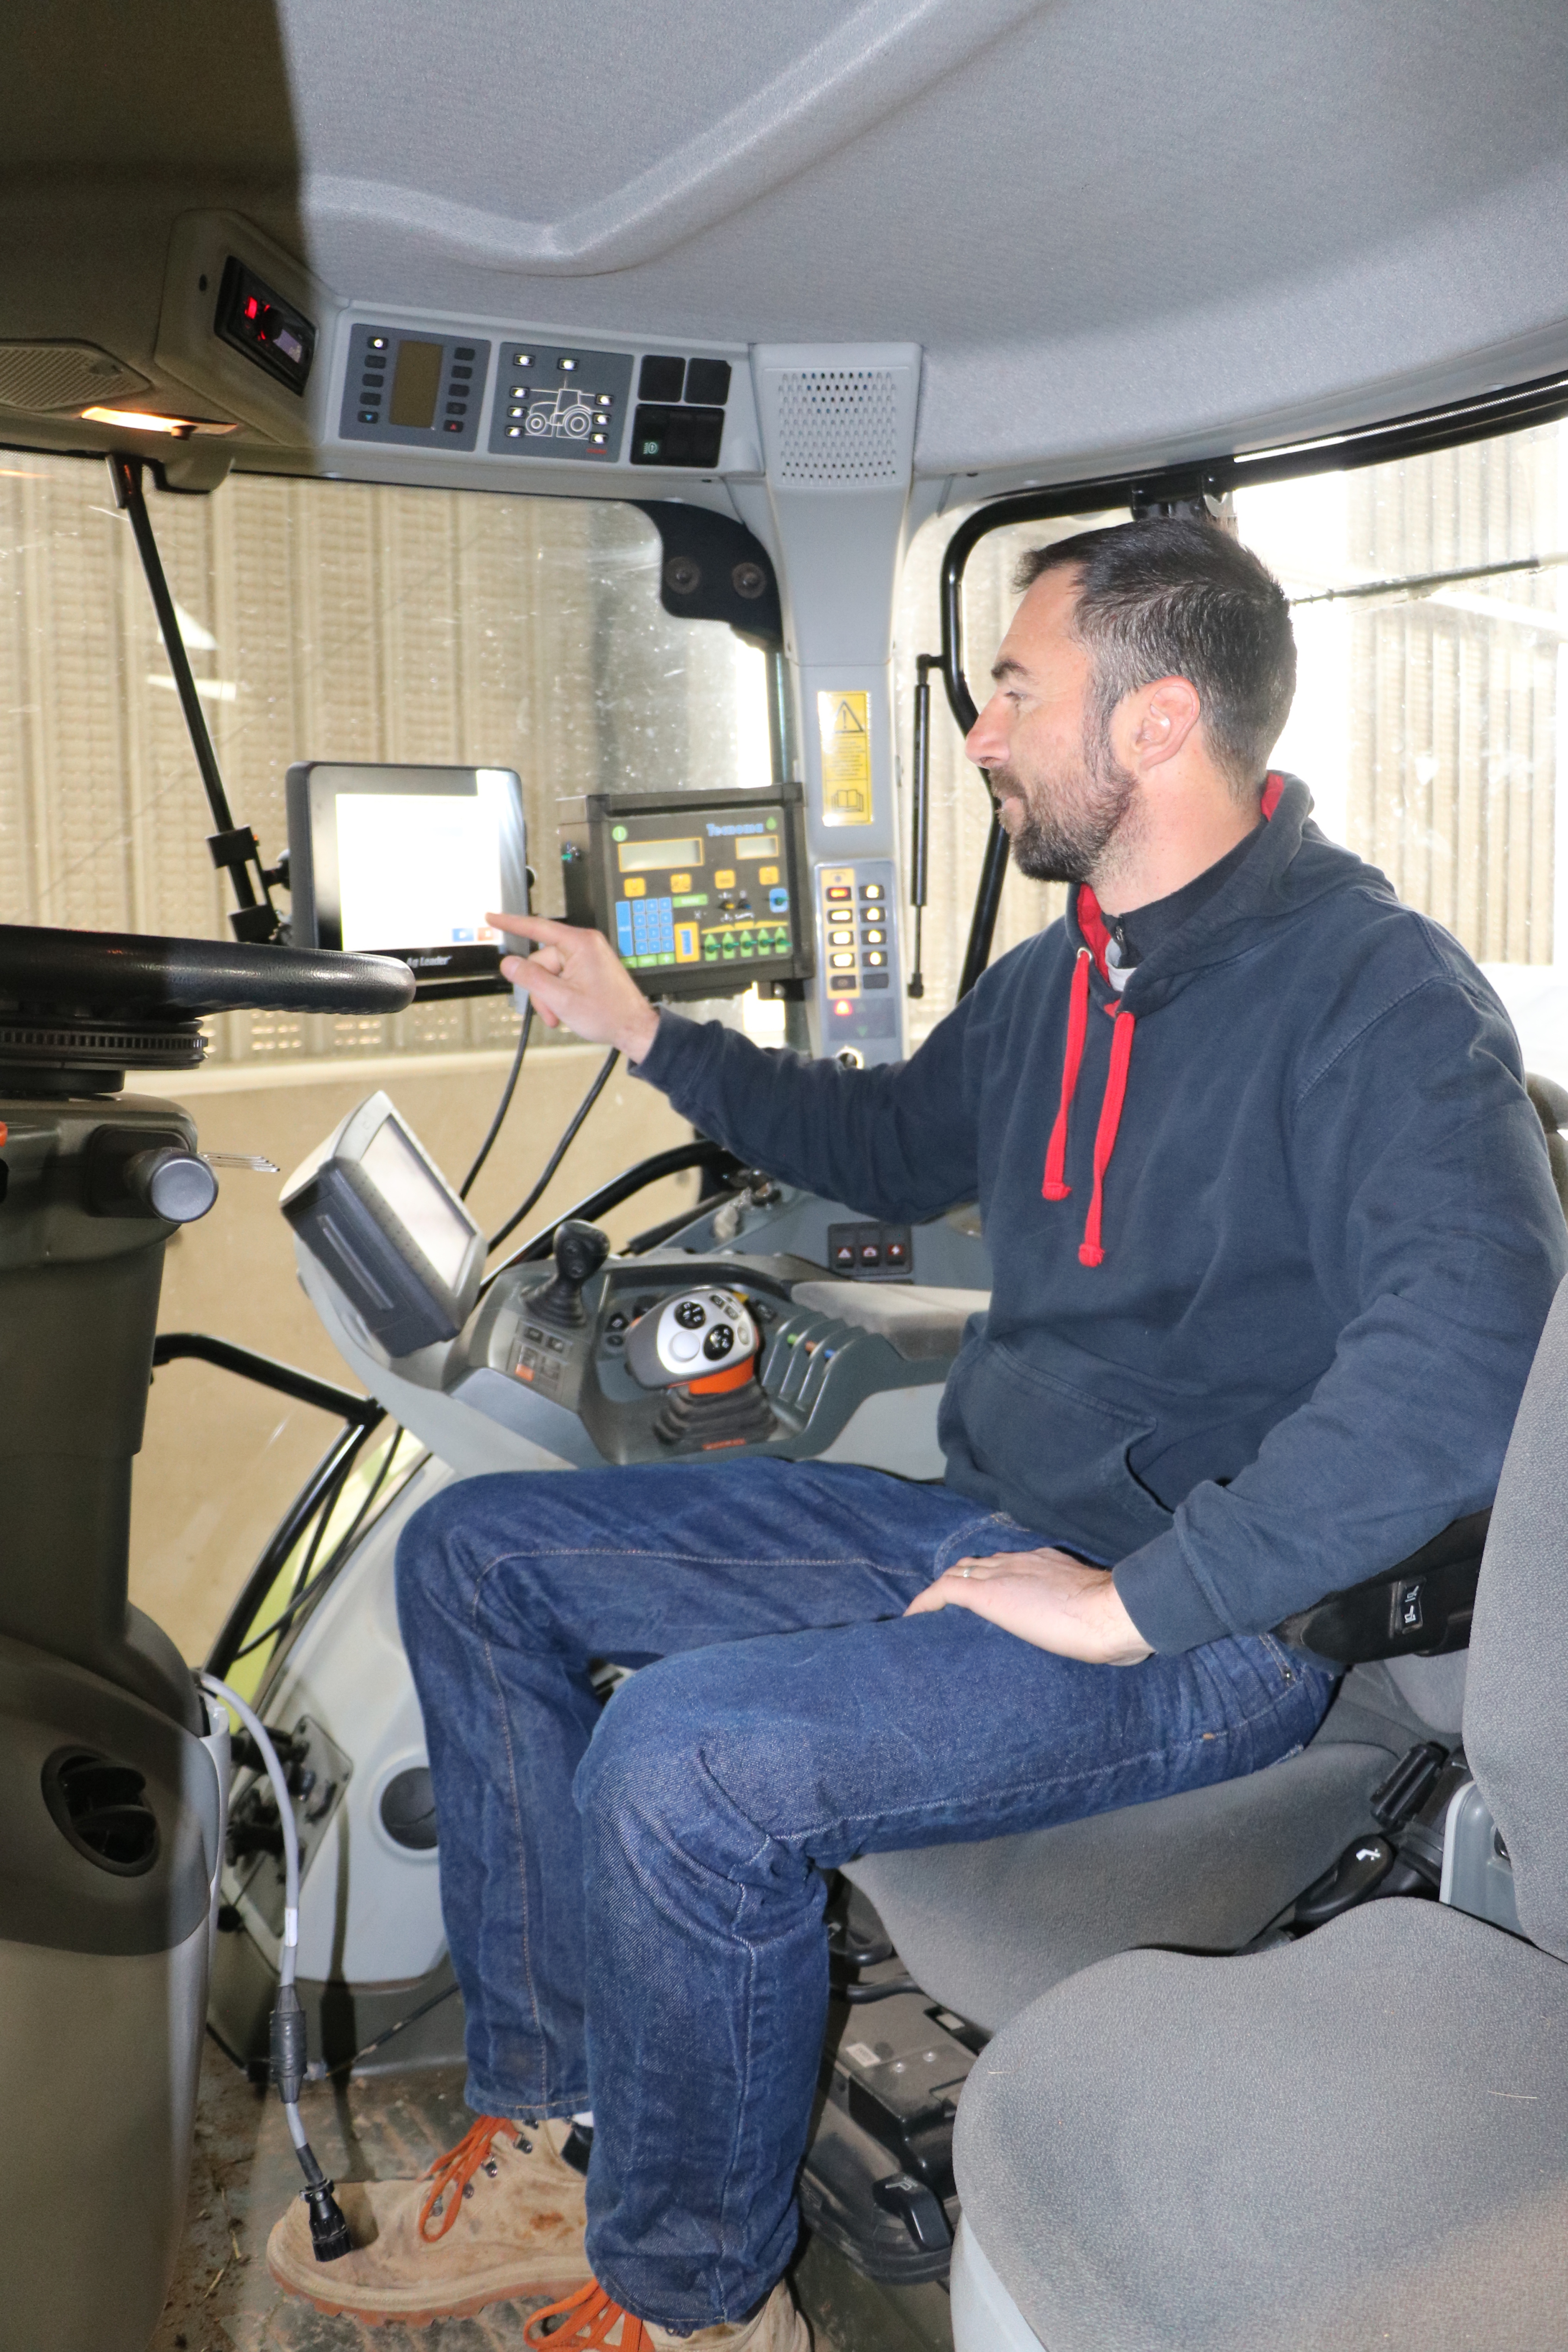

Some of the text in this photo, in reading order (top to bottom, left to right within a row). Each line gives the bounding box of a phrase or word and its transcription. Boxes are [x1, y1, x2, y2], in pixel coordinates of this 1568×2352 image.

[706, 823, 763, 837] Tecnoma
[407, 956, 448, 968] Ag Leader
